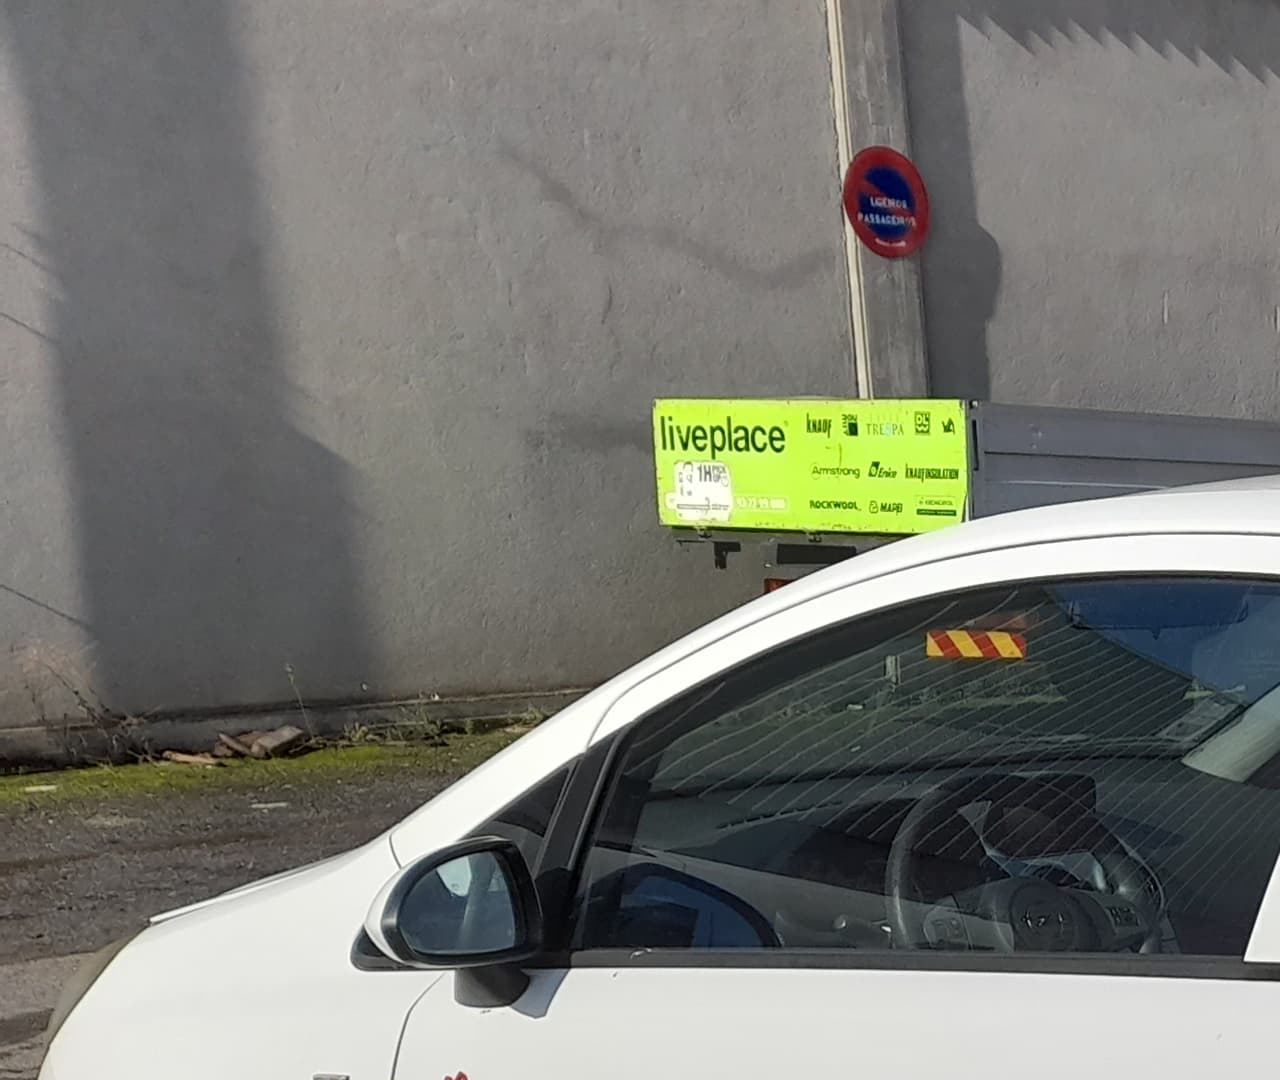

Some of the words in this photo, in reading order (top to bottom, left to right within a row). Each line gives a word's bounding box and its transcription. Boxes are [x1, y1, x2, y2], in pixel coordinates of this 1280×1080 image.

[660, 415, 786, 461] liveplace
[811, 465, 861, 480] Armstrong
[809, 499, 859, 511] ROCKWOOL
